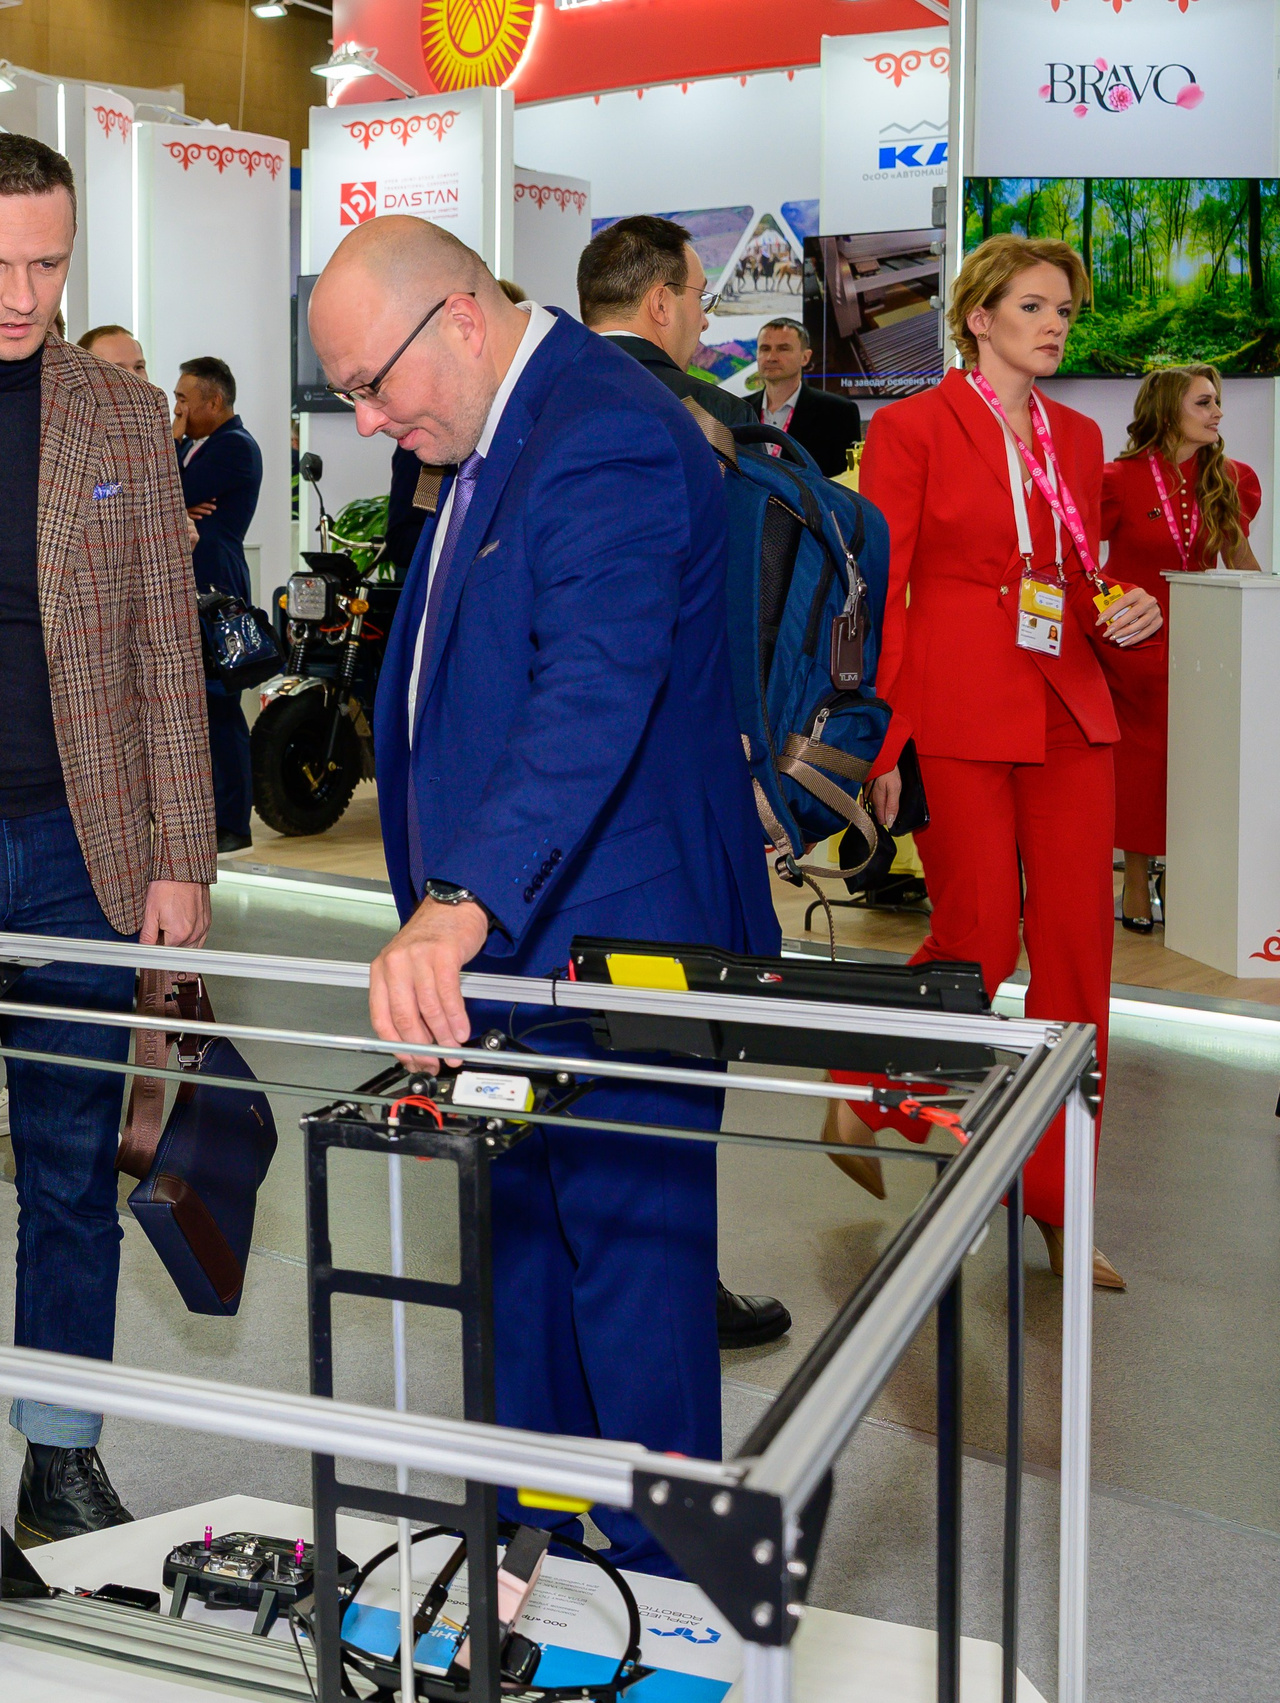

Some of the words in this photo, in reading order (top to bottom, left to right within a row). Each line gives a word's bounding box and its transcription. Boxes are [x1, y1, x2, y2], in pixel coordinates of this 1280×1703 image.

[1045, 62, 1197, 112] BRAVO
[384, 188, 458, 208] DASTAN
[841, 378, 853, 387] На
[854, 378, 886, 388] заводе
[839, 672, 858, 681] TUMI
[636, 1604, 704, 1622] ROBOTIC
[638, 1611, 700, 1627] APPLIED
